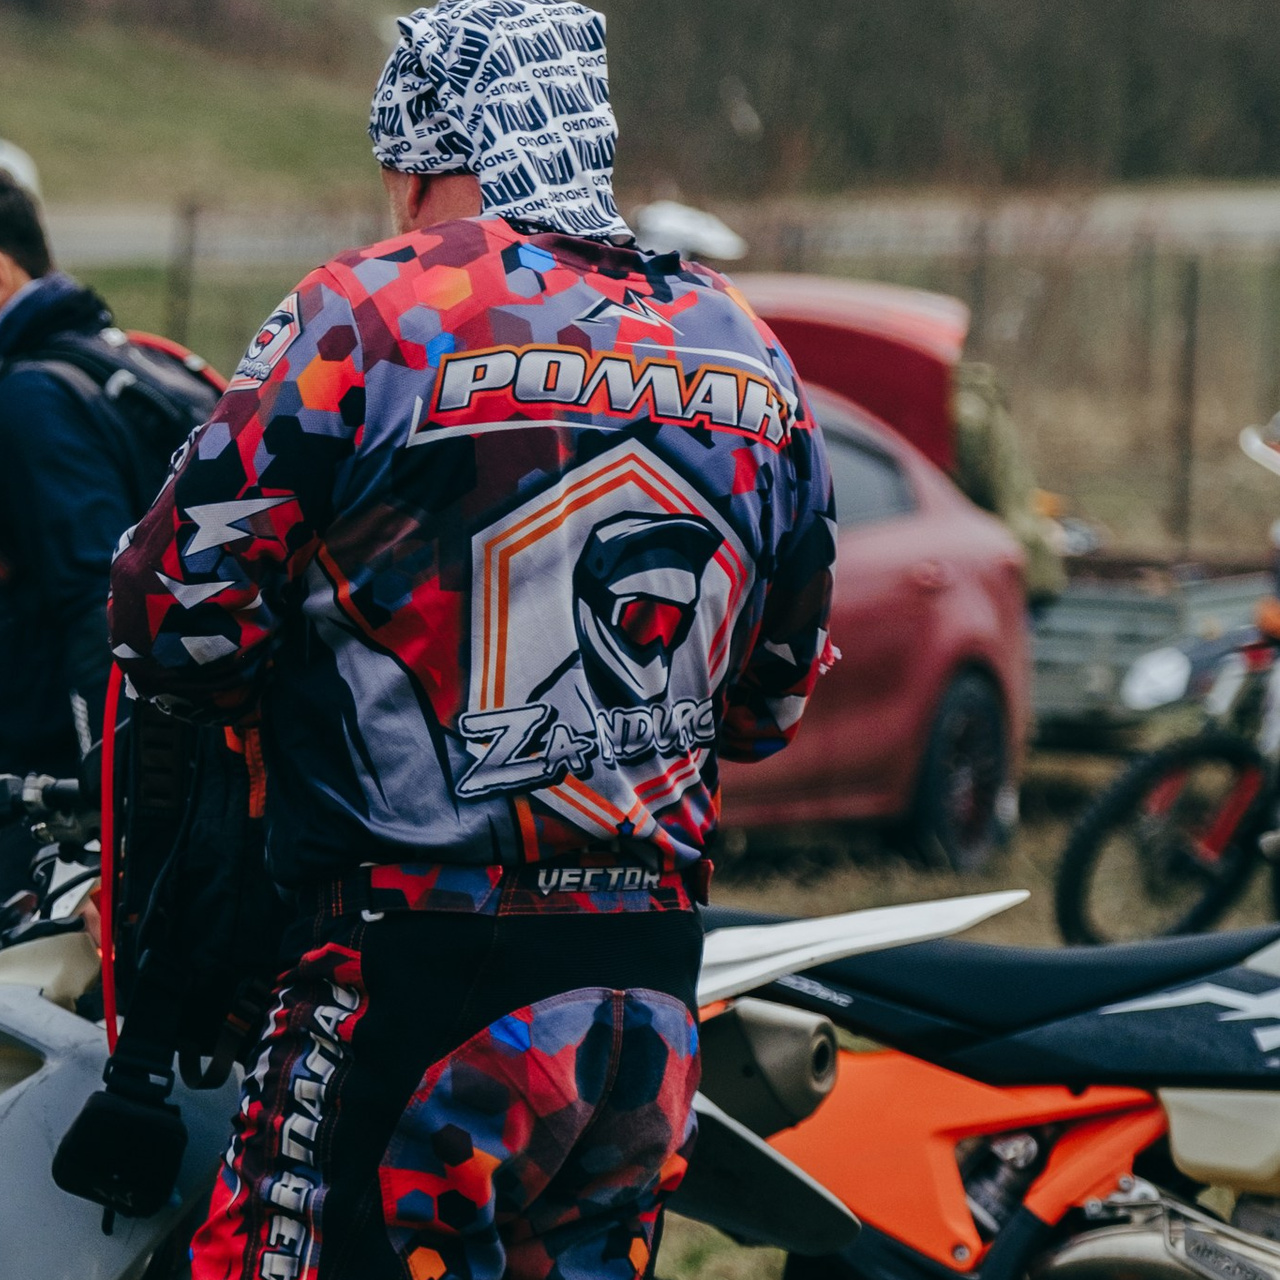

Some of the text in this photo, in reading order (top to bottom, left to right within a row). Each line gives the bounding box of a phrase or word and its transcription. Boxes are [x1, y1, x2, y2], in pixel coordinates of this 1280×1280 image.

[531, 64, 578, 79] ENDURO
[486, 80, 531, 98] ENDUR
[562, 116, 612, 133] ENDURO
[537, 866, 661, 895] VECTOR
